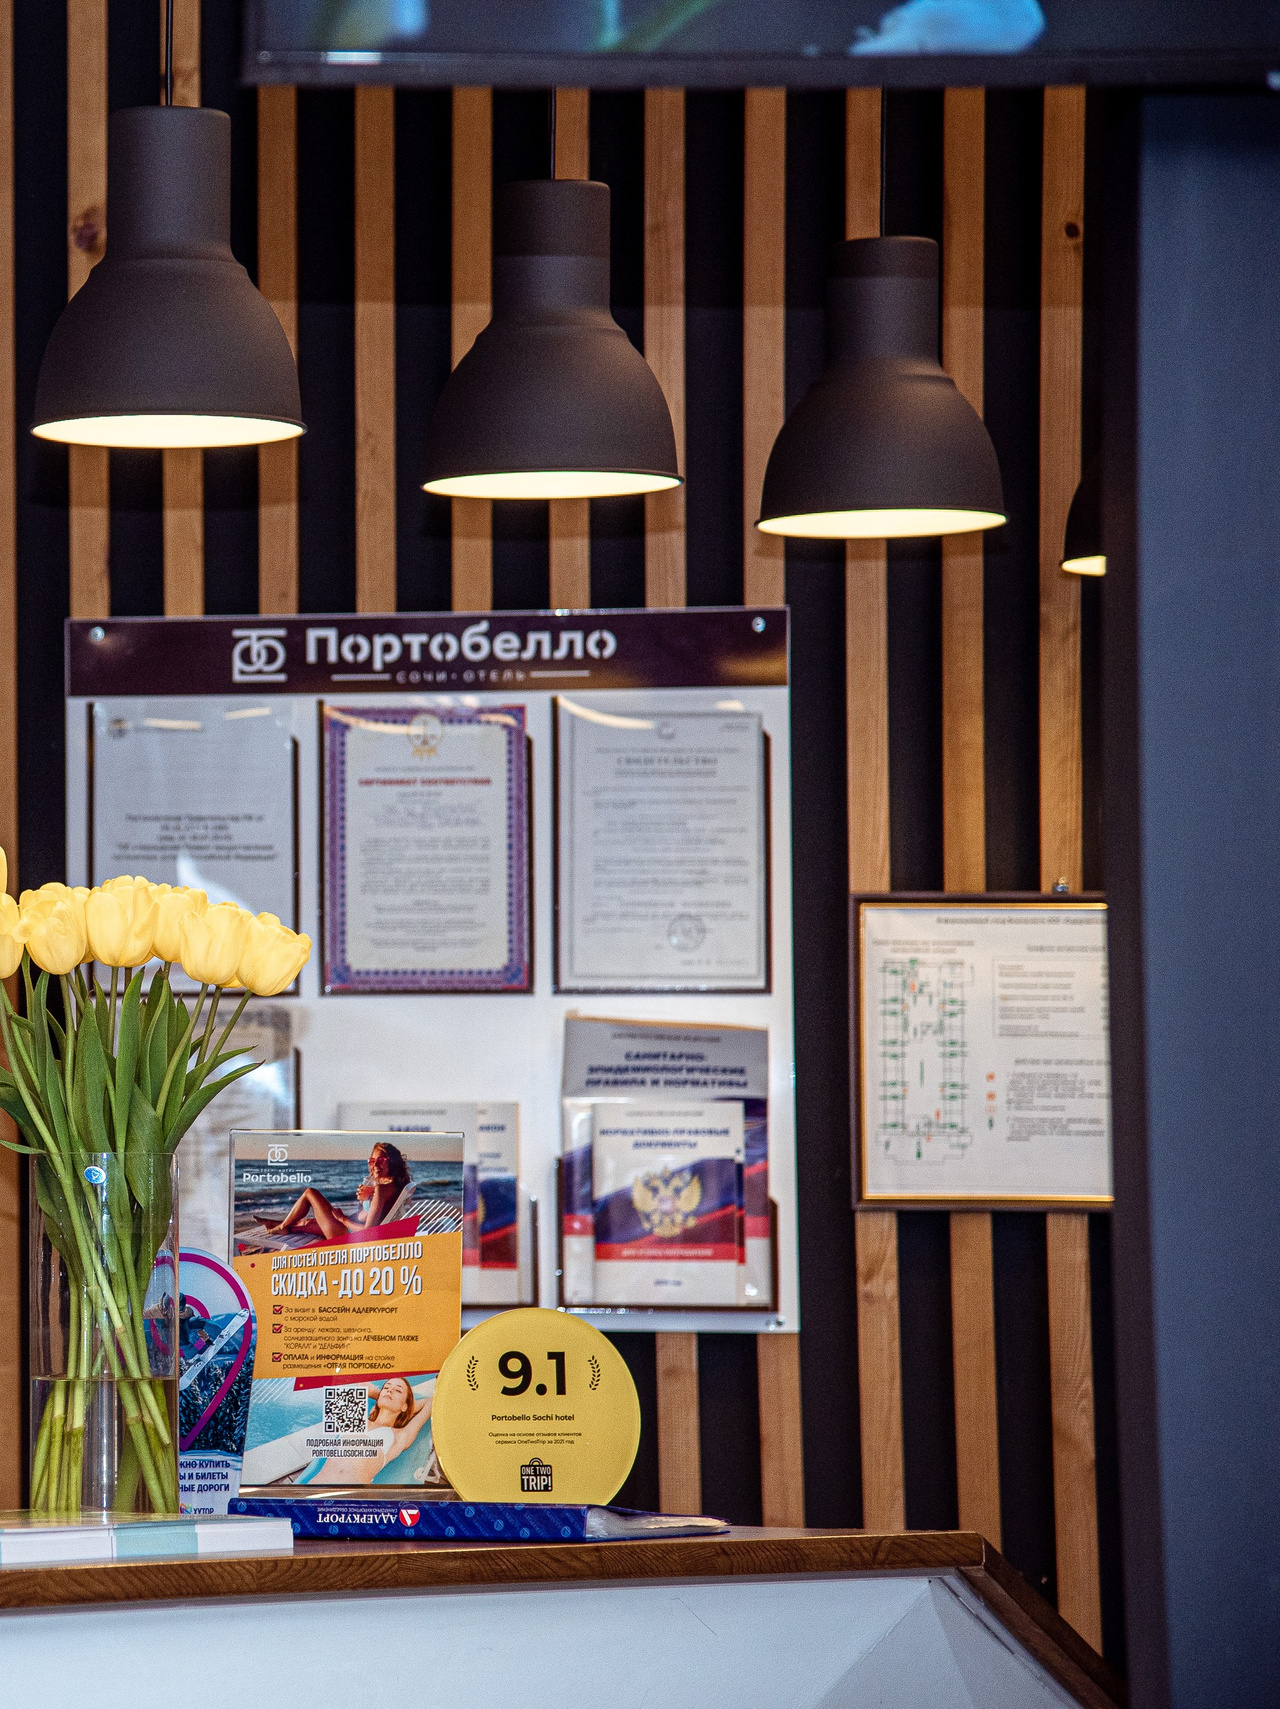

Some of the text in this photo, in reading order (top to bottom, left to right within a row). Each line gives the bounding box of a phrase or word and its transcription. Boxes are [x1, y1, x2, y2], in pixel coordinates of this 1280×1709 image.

[306, 620, 617, 671] Портобелло
[396, 669, 526, 684] СОЧИ ОТЕЛЬ
[242, 1172, 312, 1183] Portobello
[271, 1241, 422, 1271] ДЛЯ ГОСТЕЙ ОТЕЛЯ ПОРТОБЕЛЛО
[271, 1271, 328, 1298] СКИДКА
[369, 1266, 394, 1296] 20
[400, 1265, 422, 1295] %
[498, 1350, 566, 1396] 9.1
[532, 1413, 553, 1421] Sochi
[555, 1413, 575, 1421] hotel
[306, 1439, 384, 1447] ПОДРОБНАЯ ИНФОРМАЦИЯ
[312, 1449, 378, 1457] PORTOBELLOSOCHI.COM
[179, 1460, 231, 1469] ЖНО КУПИТЬ
[188, 1472, 193, 1480] И
[195, 1472, 228, 1480] БИЛЕТЫ
[521, 1466, 552, 1475] ONE TWO
[179, 1484, 230, 1493] НЫЕ ДОРОГИ
[522, 1476, 552, 1490] TRIP!
[316, 1513, 398, 1524] АДЛЕРКУРОРТ
